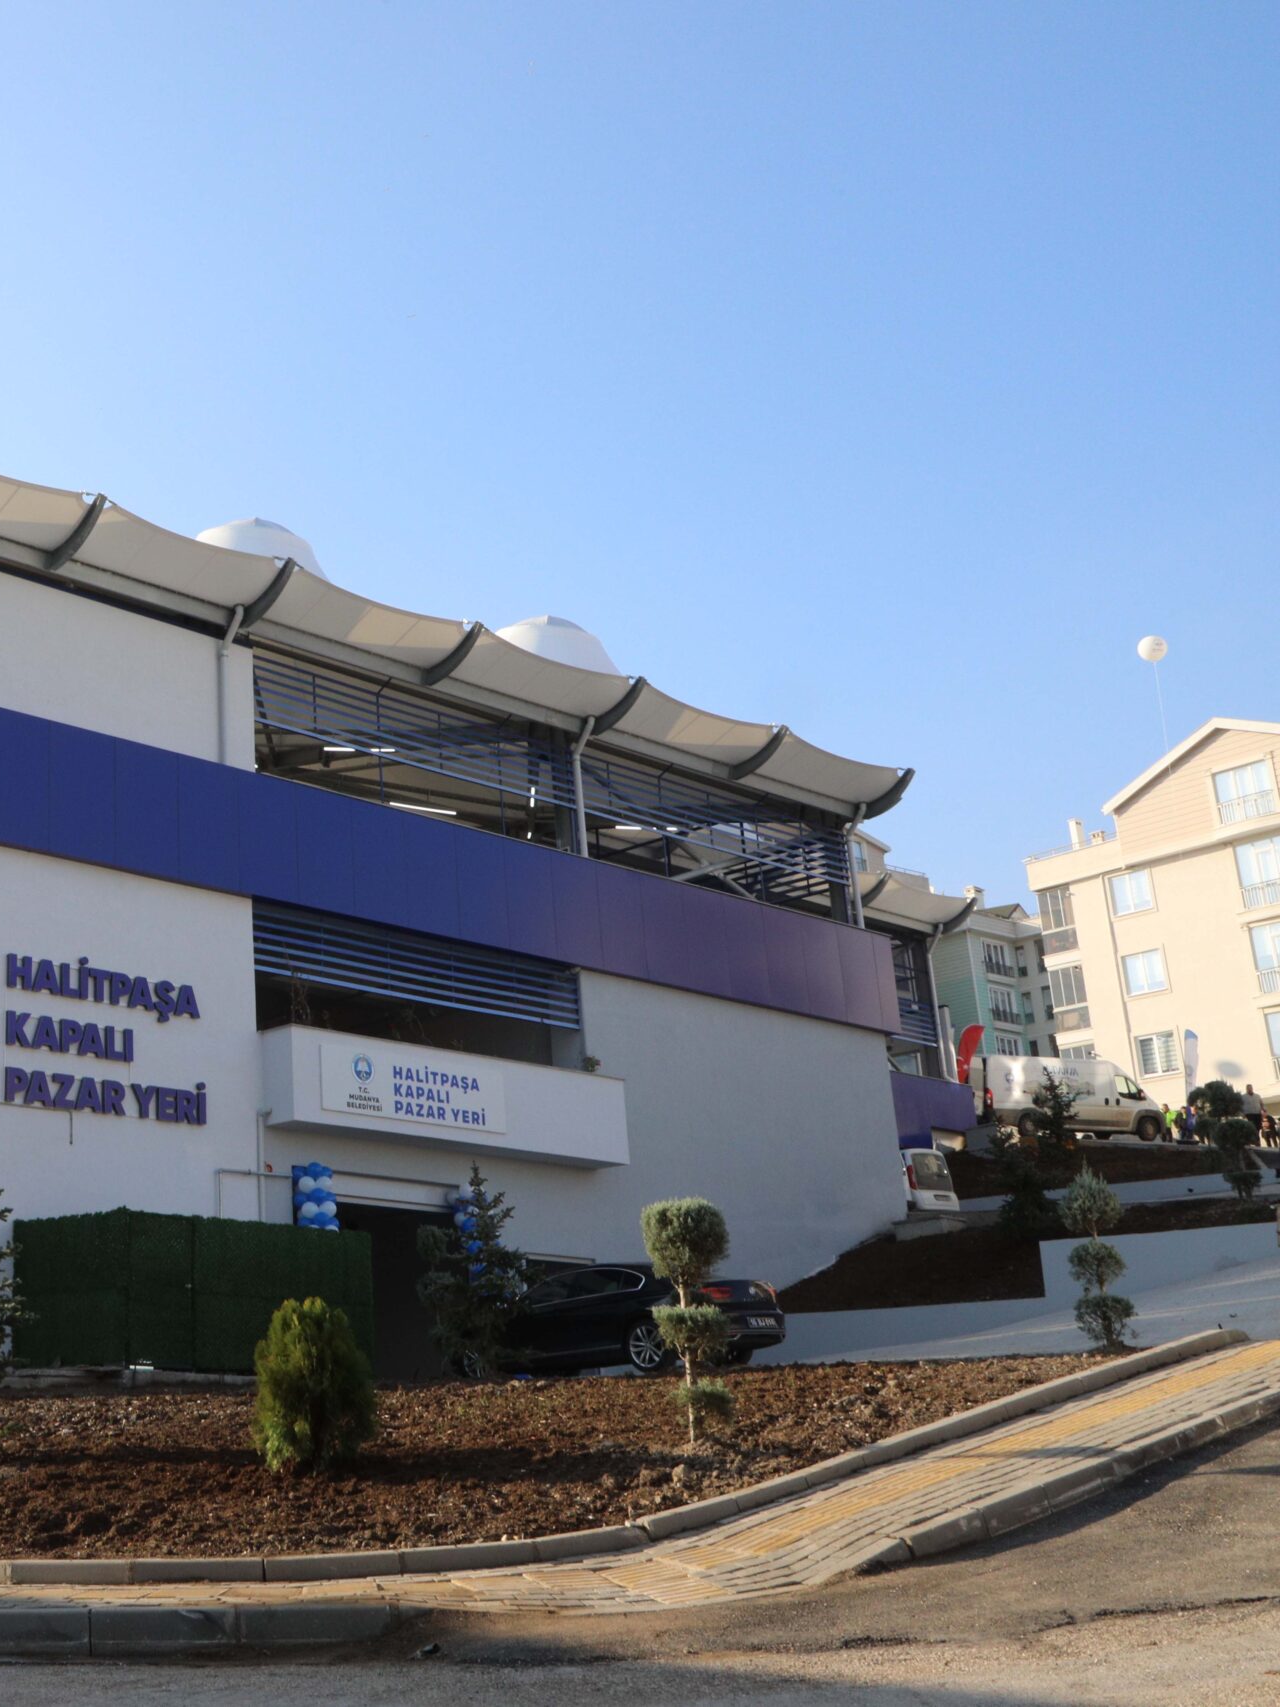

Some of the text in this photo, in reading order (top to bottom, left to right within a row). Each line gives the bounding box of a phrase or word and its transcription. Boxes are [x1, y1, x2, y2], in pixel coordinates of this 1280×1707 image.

[6, 953, 200, 1022] HALİTPAŞA
[5, 1010, 133, 1062] KAPALI
[392, 1065, 480, 1094] HALİTPAŞA
[393, 1082, 450, 1104] KAPALI
[4, 1066, 207, 1125] PAZAR YERİ
[349, 1093, 380, 1103] MUDANYA
[394, 1100, 486, 1126] PAZAR YERİ
